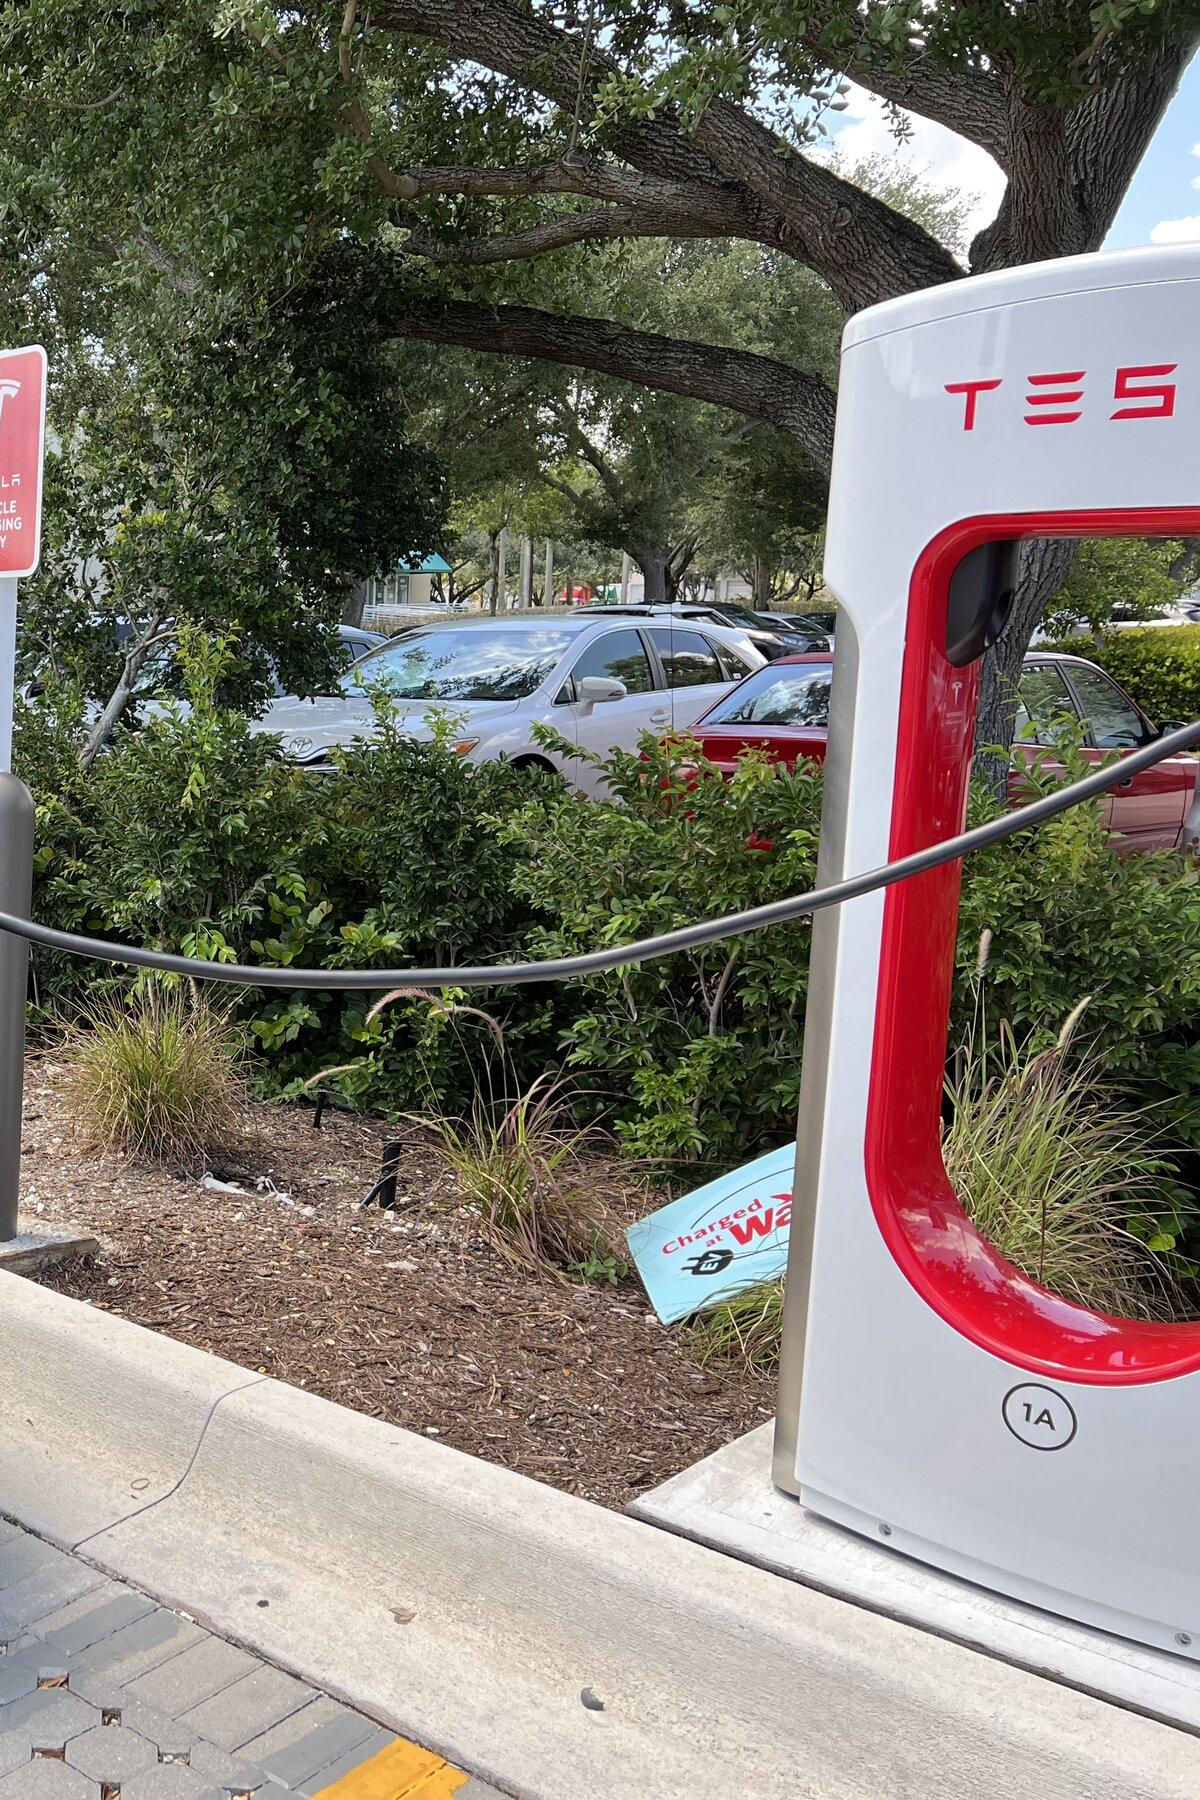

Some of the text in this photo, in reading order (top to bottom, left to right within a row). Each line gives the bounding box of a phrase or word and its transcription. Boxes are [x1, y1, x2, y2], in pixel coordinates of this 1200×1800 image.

[661, 1198, 763, 1255] Charged
[705, 1234, 724, 1247] at
[1022, 1402, 1056, 1431] 1A
